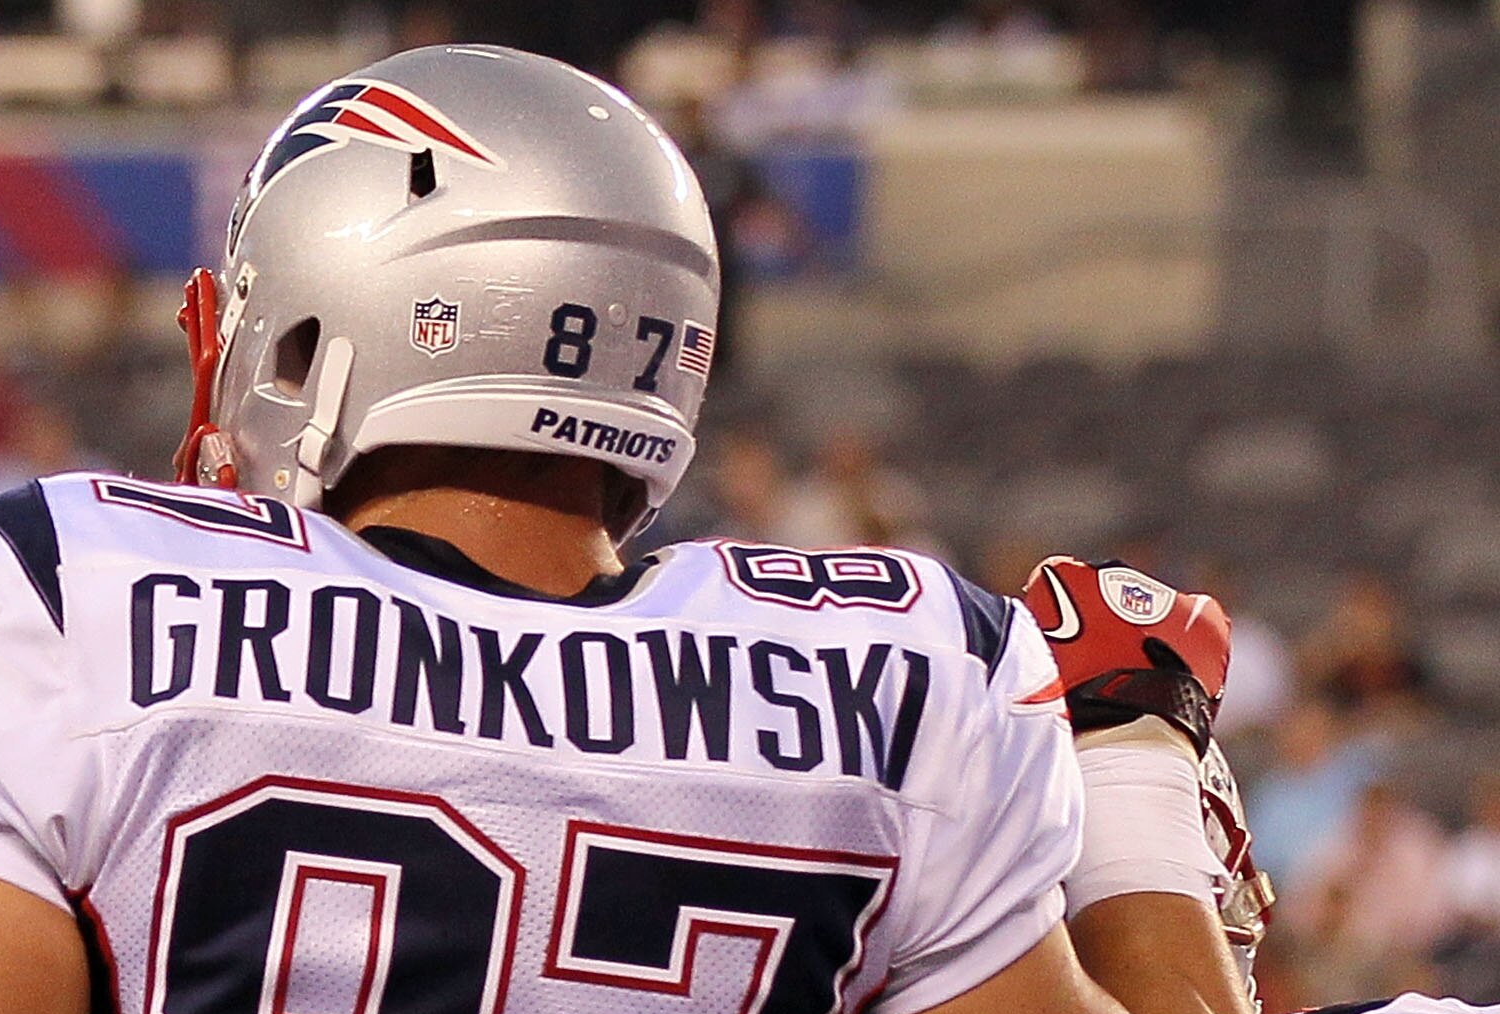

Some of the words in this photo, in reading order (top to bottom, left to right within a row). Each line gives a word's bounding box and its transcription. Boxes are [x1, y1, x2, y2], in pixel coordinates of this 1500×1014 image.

[416, 319, 453, 346] NFL
[531, 407, 677, 464] PATRIOTS
[1123, 595, 1153, 616] NFL
[129, 571, 931, 792] GRONKOWSKI
